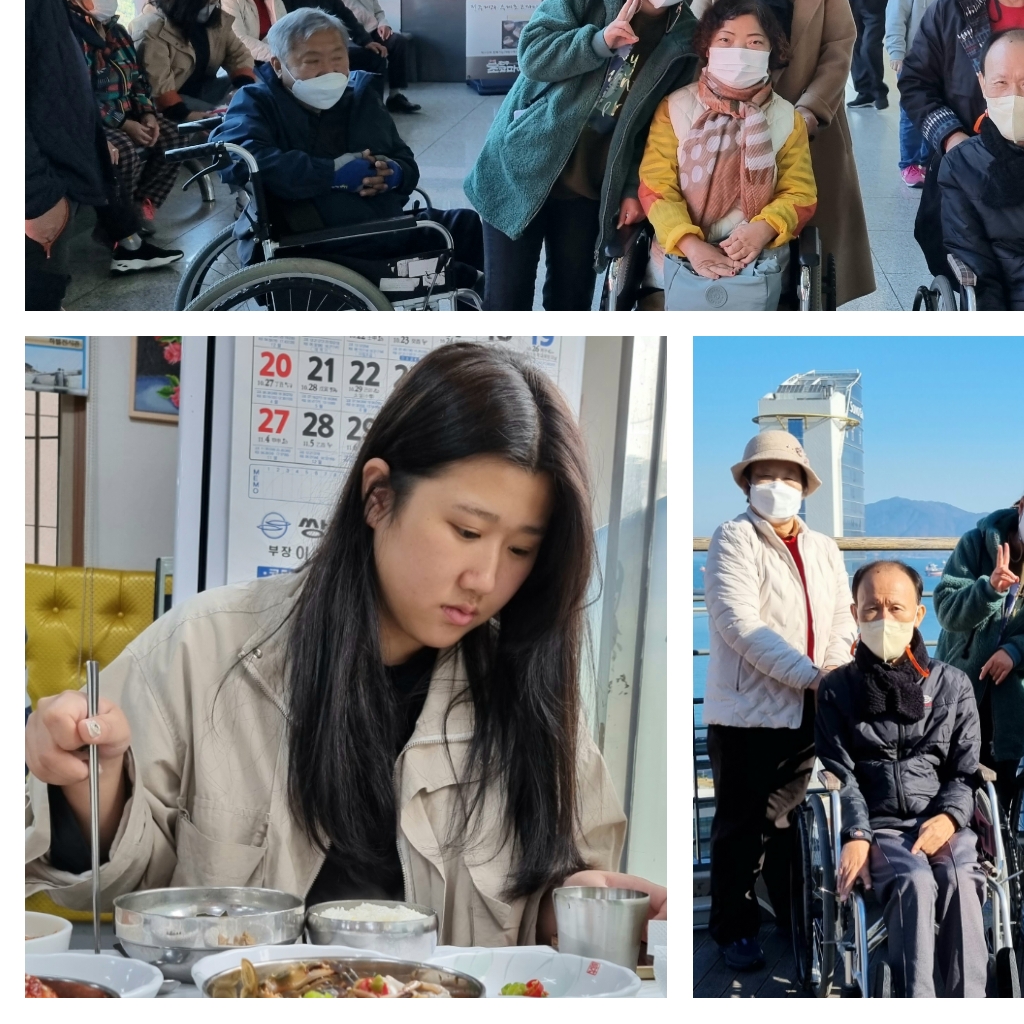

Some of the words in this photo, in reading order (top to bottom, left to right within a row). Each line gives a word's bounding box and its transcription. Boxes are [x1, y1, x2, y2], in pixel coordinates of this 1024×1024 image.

[259, 351, 292, 378] 20
[307, 356, 334, 383] 21
[349, 360, 380, 387] 22
[258, 408, 290, 434] 27
[302, 412, 334, 438] 28
[268, 545, 291, 558] 부장
